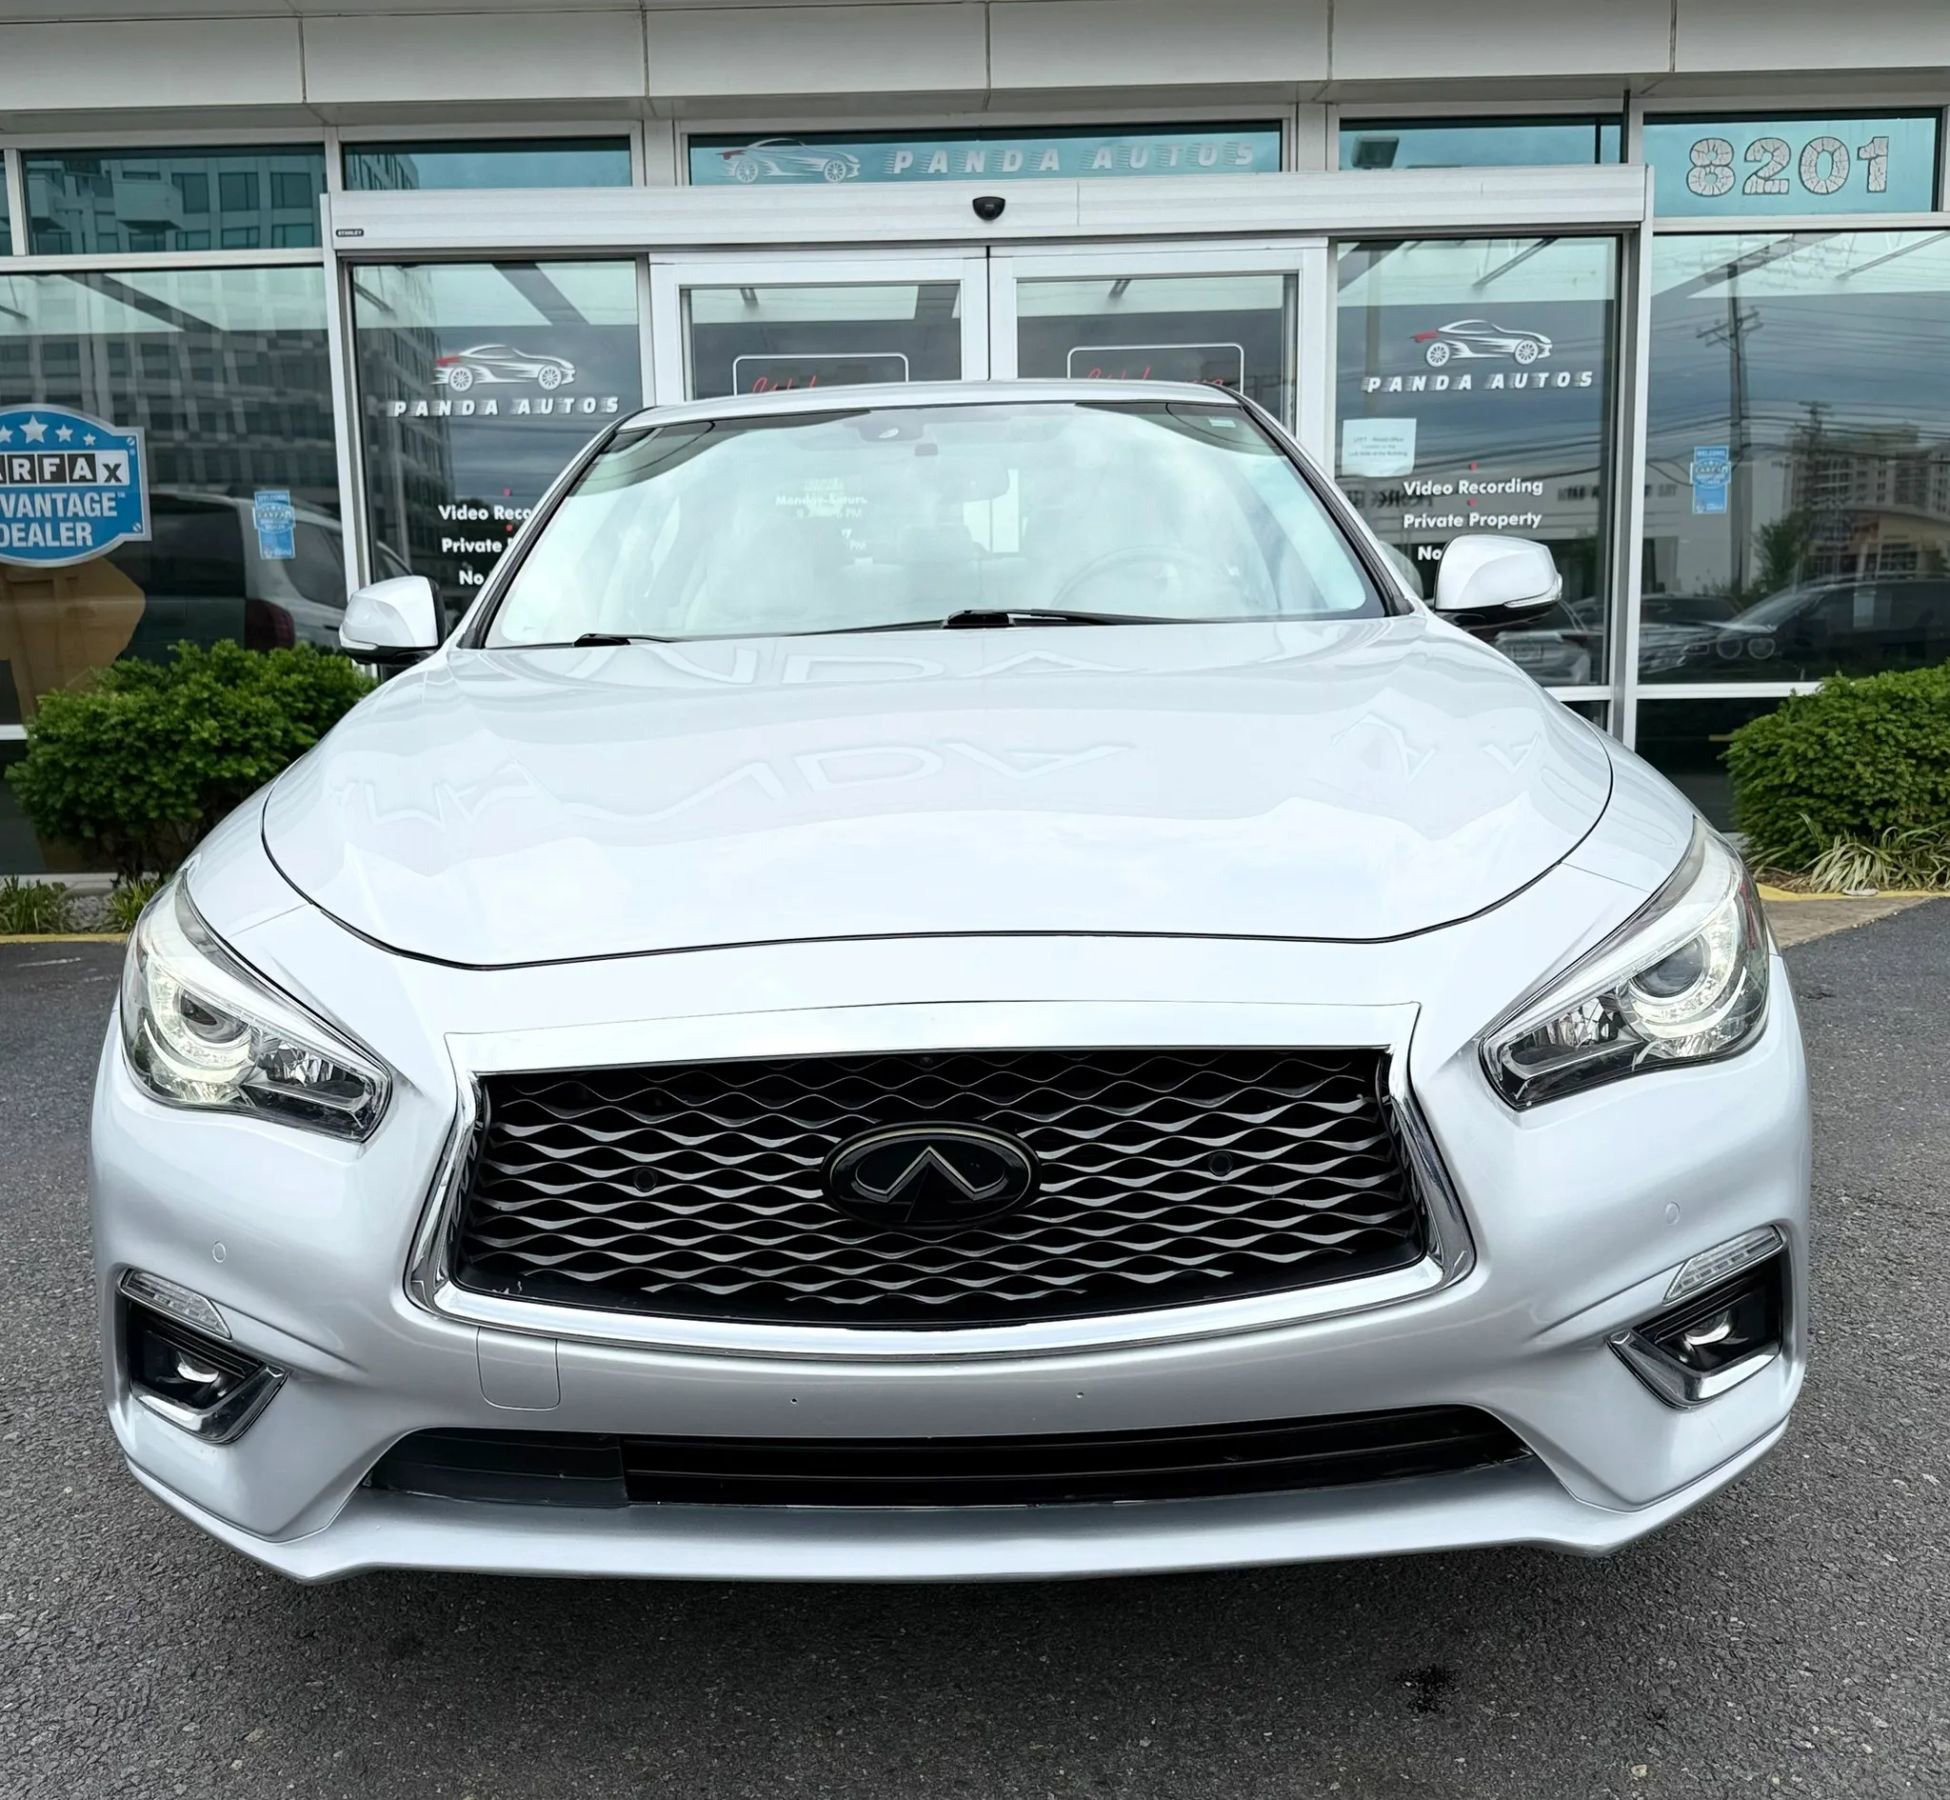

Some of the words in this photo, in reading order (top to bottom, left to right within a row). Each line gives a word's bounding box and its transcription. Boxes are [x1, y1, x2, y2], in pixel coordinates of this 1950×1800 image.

[885, 148, 1060, 174] PANDA
[1083, 144, 1254, 169] AUTOS
[1686, 136, 1889, 197] 8201
[1363, 374, 1472, 393] PANDA
[1486, 371, 1592, 389] AUTOS
[388, 399, 498, 417] PANDA
[513, 397, 618, 415] AUTOS
[0, 457, 122, 483] RFAX
[1403, 480, 1453, 496] Video
[1458, 478, 1543, 496] Recording
[438, 504, 489, 520] Video
[1403, 513, 1464, 529] Private
[1469, 512, 1542, 529] Property
[442, 537, 503, 553] Private
[1418, 546, 1442, 560] No
[459, 569, 485, 585] No
